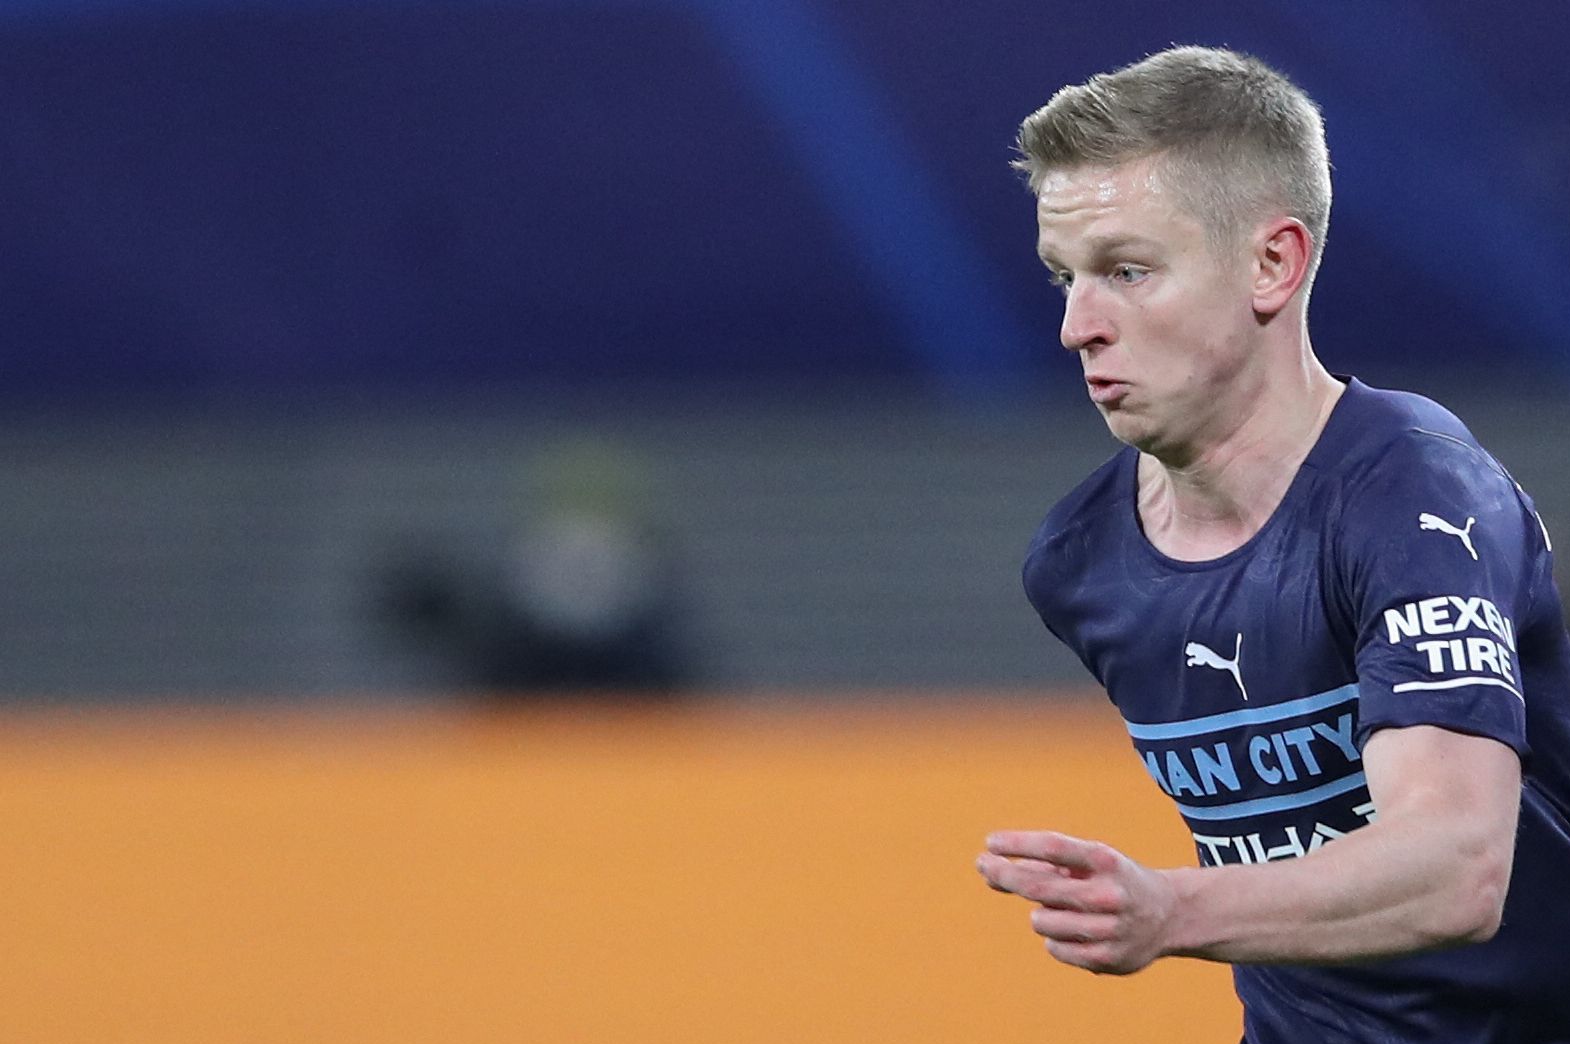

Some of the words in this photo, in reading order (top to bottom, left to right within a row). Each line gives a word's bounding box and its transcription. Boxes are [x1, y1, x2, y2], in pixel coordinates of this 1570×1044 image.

[1384, 596, 1516, 652] NEXEN
[1416, 638, 1516, 685] TIRE
[1248, 713, 1361, 786] CITY
